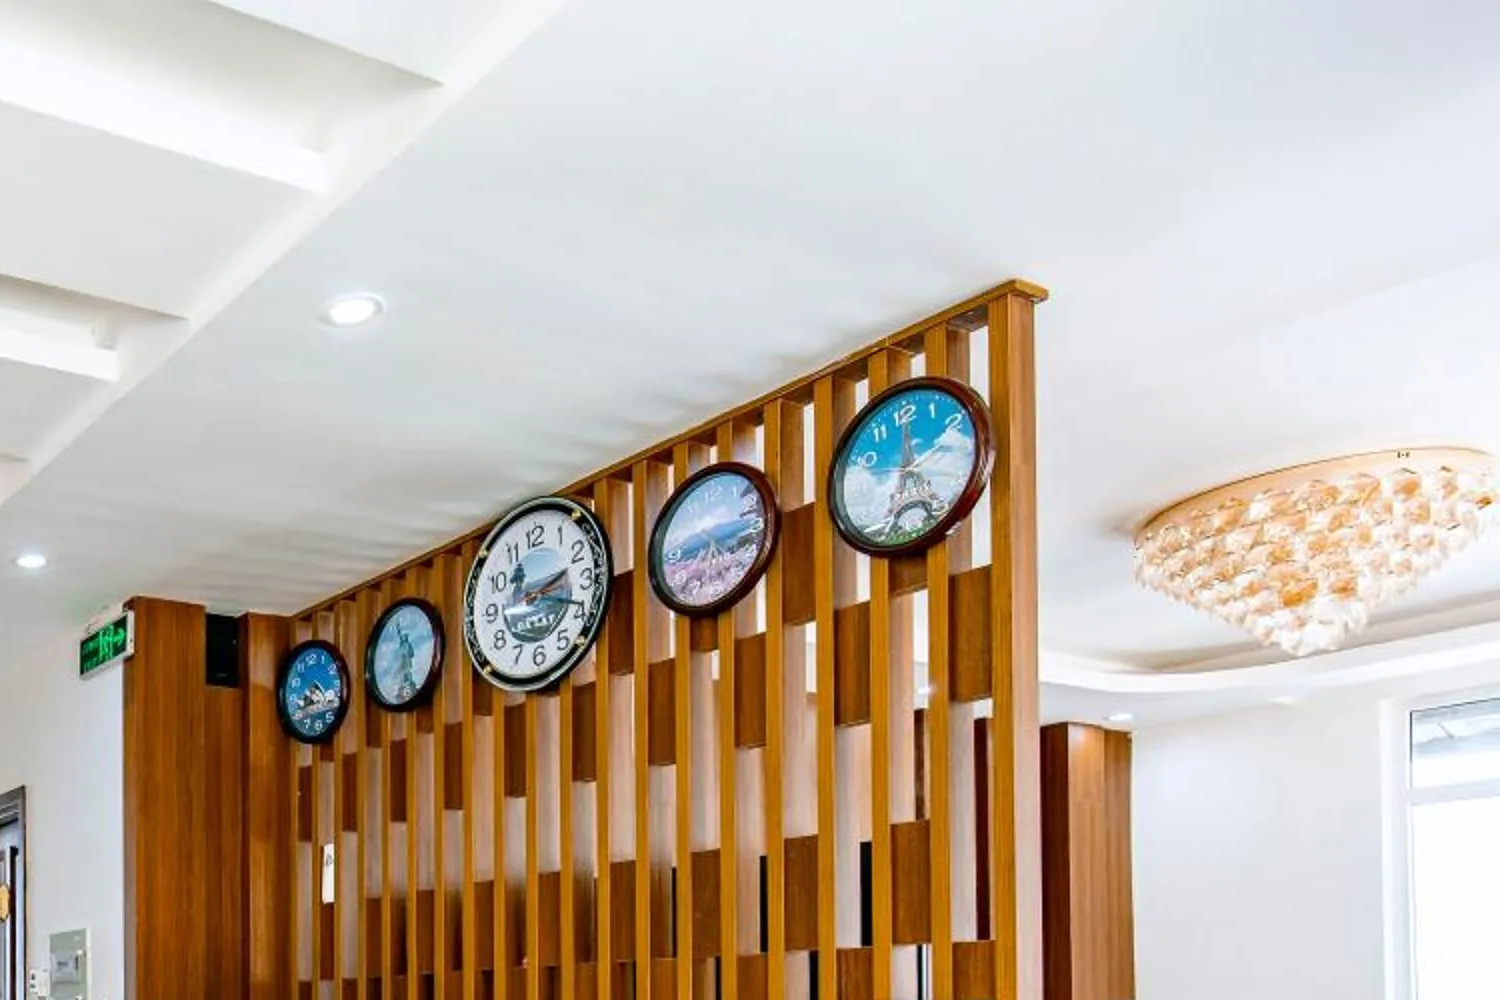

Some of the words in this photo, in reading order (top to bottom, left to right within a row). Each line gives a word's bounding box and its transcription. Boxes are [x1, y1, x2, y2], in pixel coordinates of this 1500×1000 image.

[893, 404, 917, 427] 12
[928, 402, 936, 419] 1
[944, 412, 963, 431] 2
[873, 424, 887, 443] 11
[705, 485, 723, 503] 12
[732, 487, 738, 497] 1
[525, 524, 545, 550] 12
[557, 525, 564, 545] 1
[506, 541, 519, 563] 11
[571, 539, 585, 564] 2
[490, 571, 507, 594] 10
[579, 567, 593, 590] 3
[485, 603, 498, 623] 9
[573, 600, 586, 621] 4
[493, 629, 507, 650] 8
[556, 629, 570, 651] 5
[306, 653, 317, 665] 12
[513, 644, 524, 664] 7
[532, 645, 546, 666] 6
[297, 663, 305, 673] 11
[304, 719, 311, 729] 7
[325, 711, 334, 723] 5
